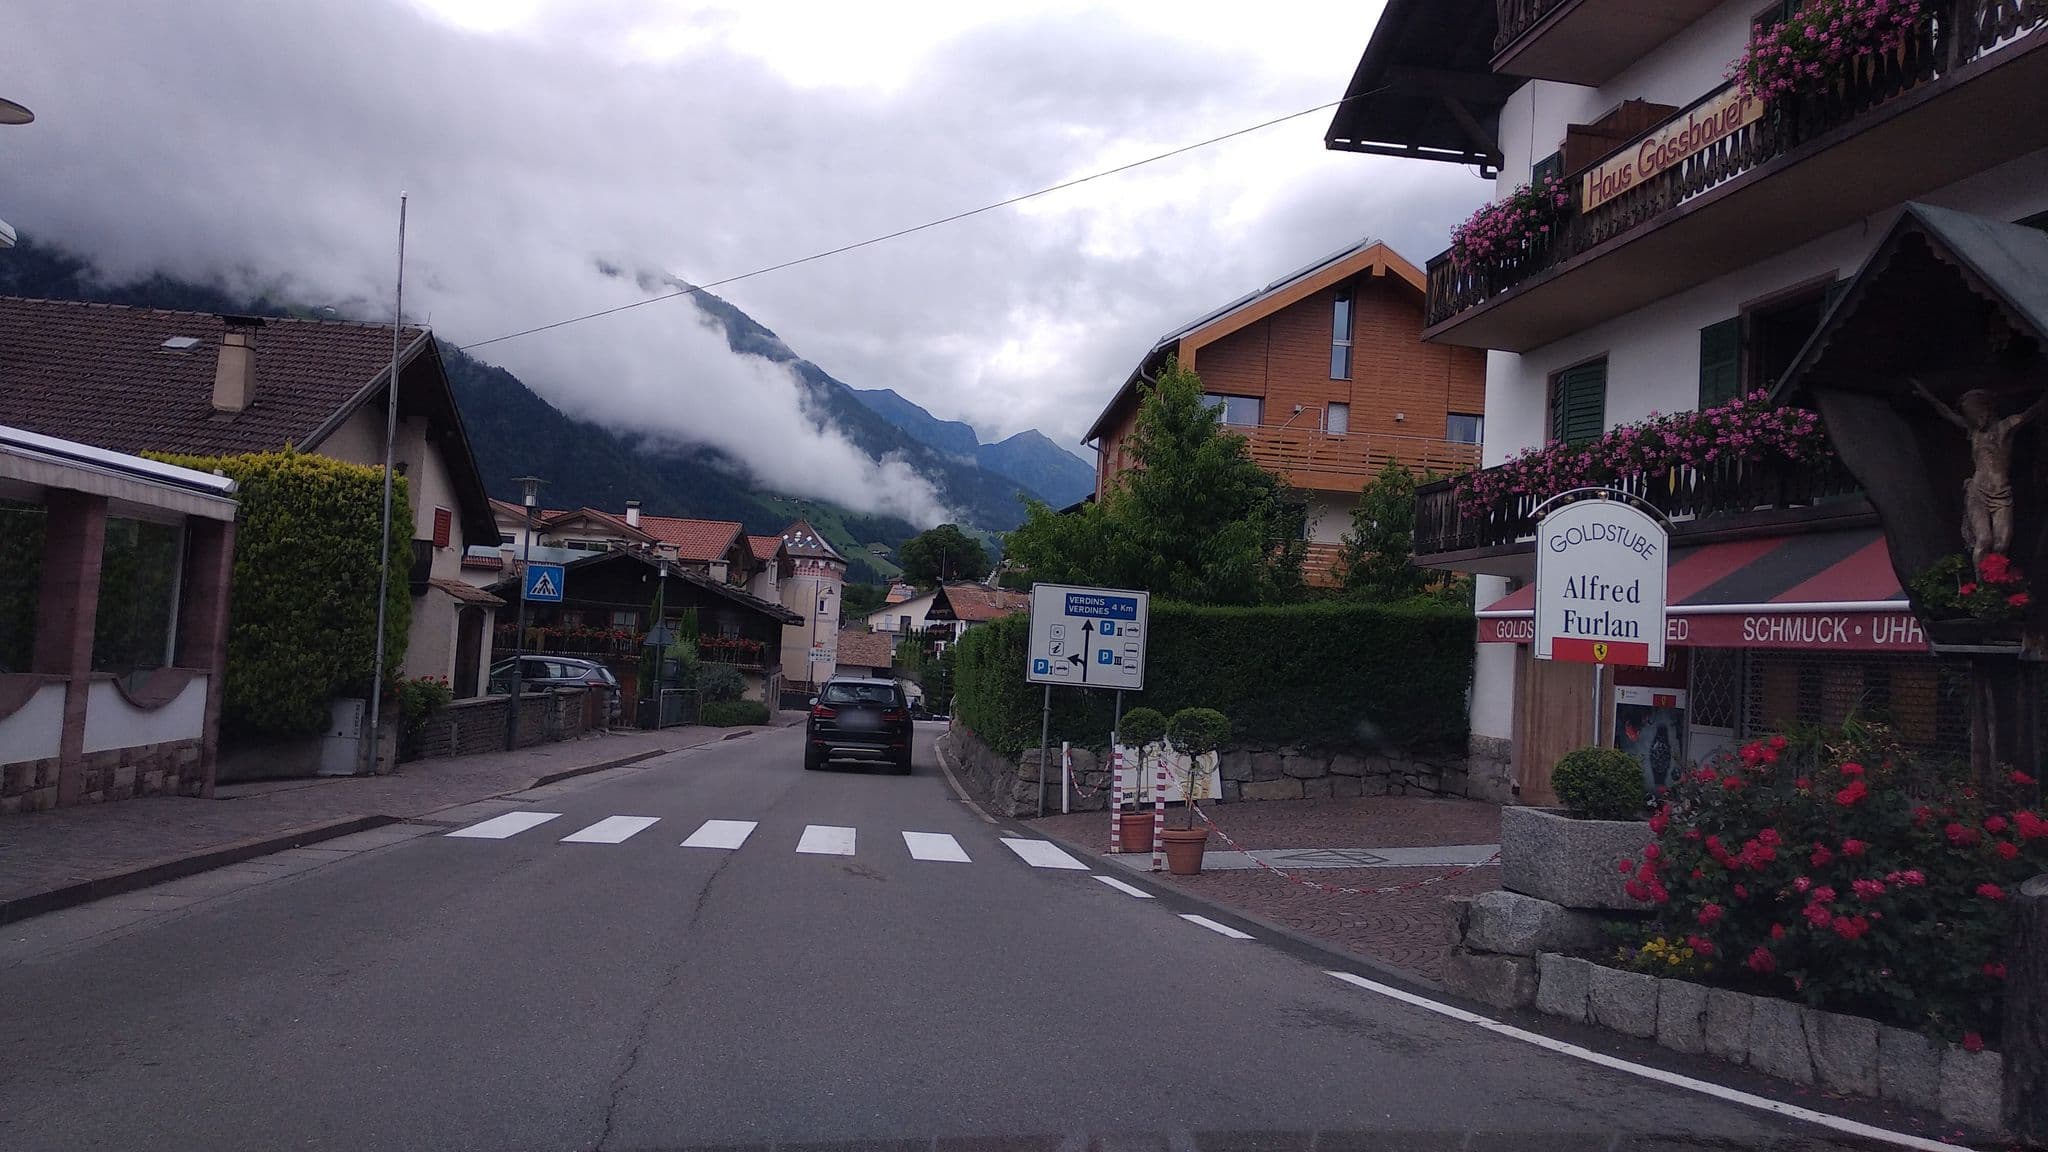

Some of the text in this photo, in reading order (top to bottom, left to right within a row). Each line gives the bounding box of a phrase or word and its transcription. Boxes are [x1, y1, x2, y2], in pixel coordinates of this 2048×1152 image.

[1589, 166, 1632, 207] Haus
[1550, 523, 1658, 560] GOLDSTUBE
[1069, 596, 1106, 606] VERDINS
[1562, 575, 1641, 604] Alfred
[1068, 604, 1110, 615] VERDINES
[1111, 603, 1134, 613] 4 Km
[1496, 620, 1535, 639] GOLDS
[1743, 616, 1849, 643] SCHMUCK
[1872, 616, 1924, 644] UHR
[1562, 609, 1640, 638] Furlan
